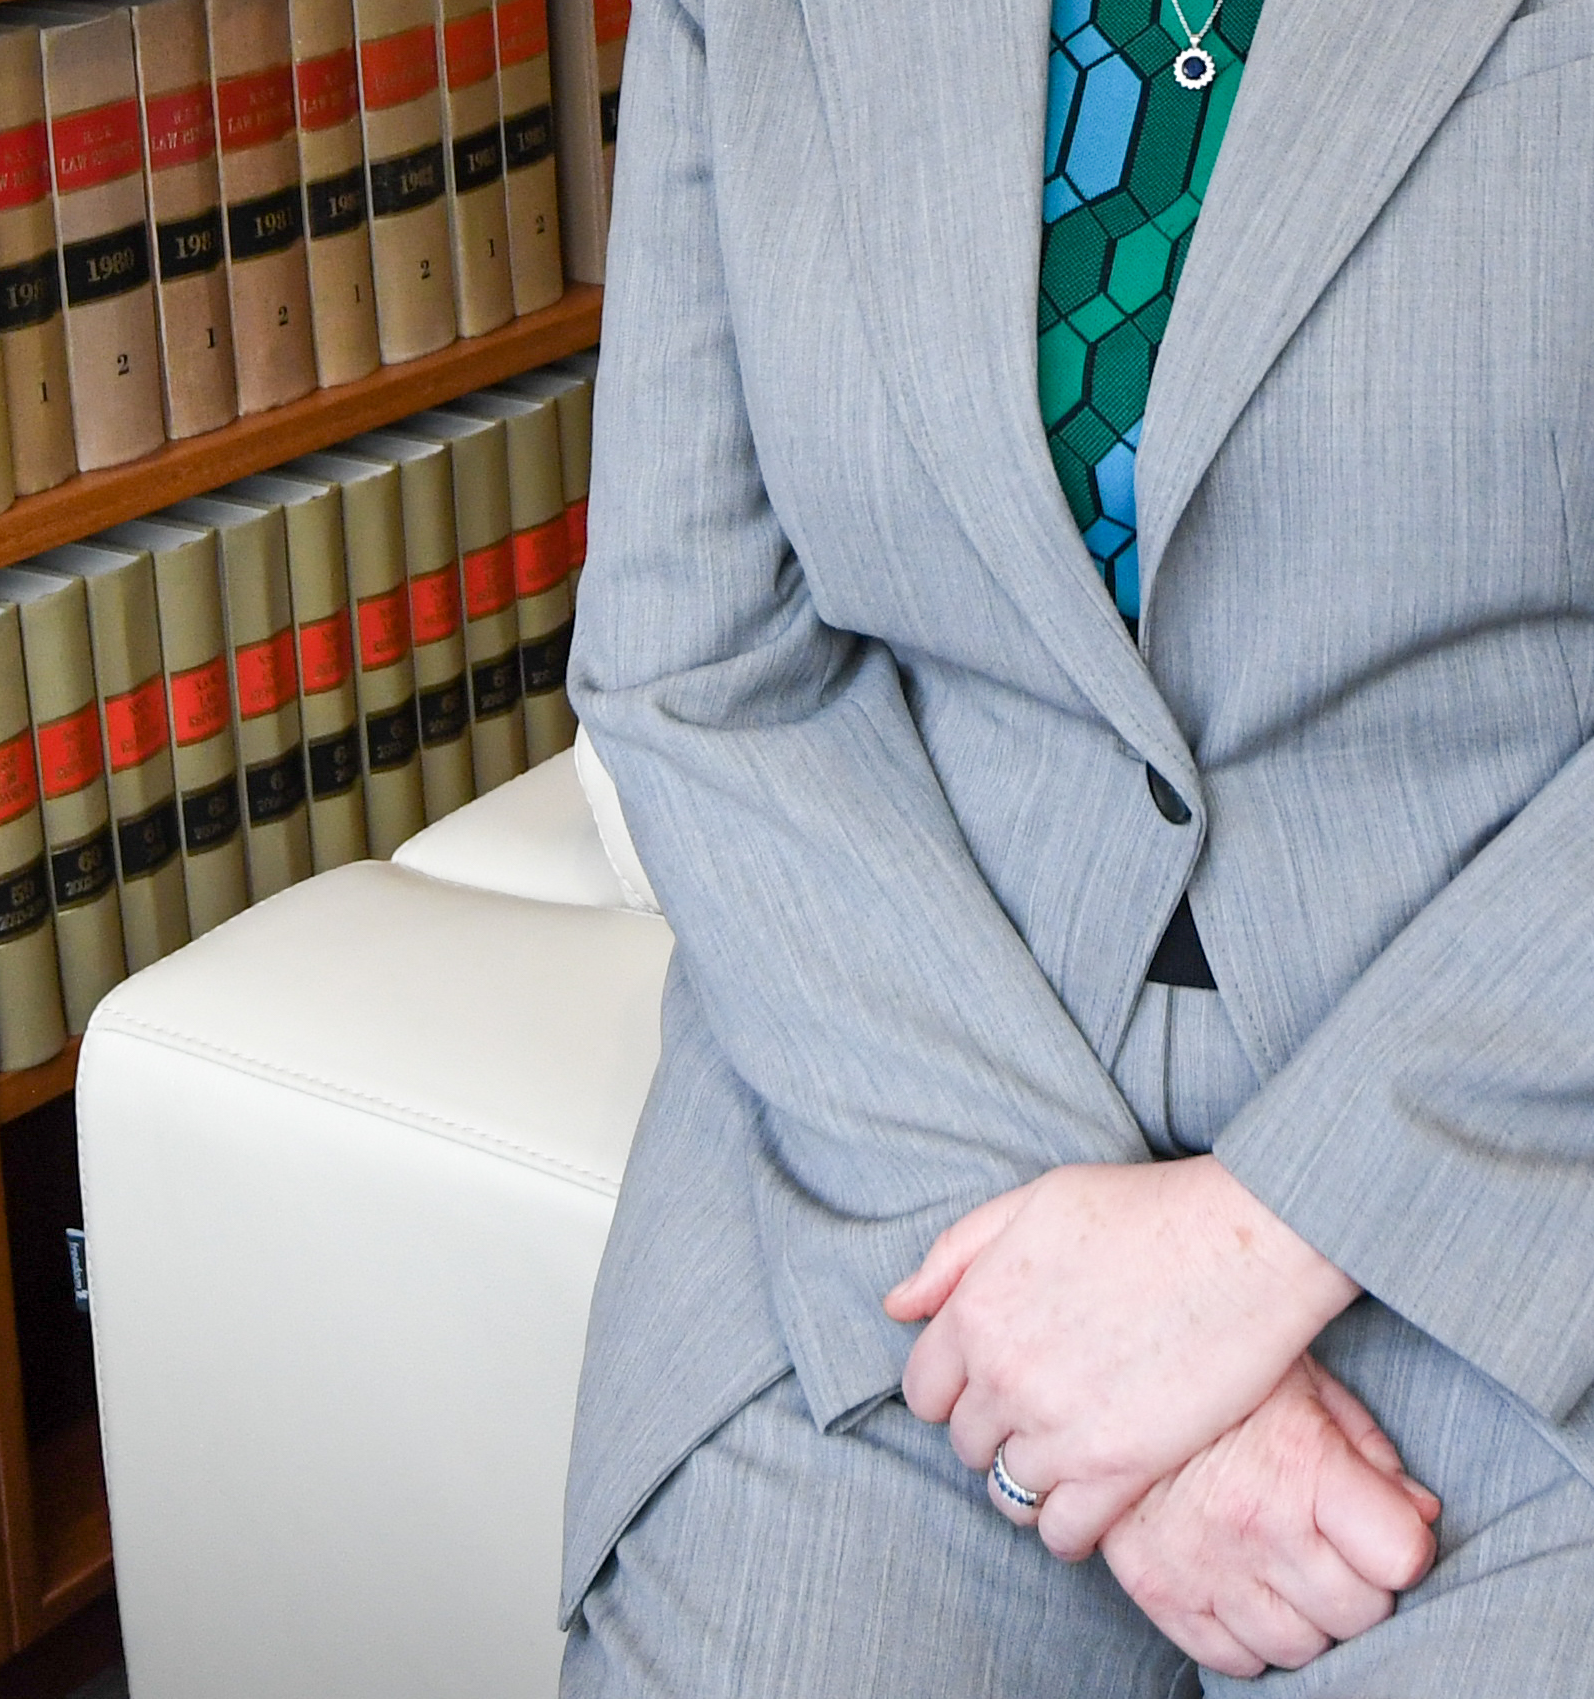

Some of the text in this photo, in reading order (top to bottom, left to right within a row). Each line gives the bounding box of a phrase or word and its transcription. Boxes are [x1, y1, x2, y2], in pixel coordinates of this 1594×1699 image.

[536, 215, 545, 234] 2
[175, 229, 213, 260] 198
[488, 238, 496, 258] 1
[85, 249, 135, 283] 1980
[420, 259, 431, 280] 2
[354, 284, 362, 304] 1
[278, 305, 289, 327] 2
[207, 327, 216, 349] 1
[117, 353, 130, 376] 2
[41, 381, 49, 403] 1
